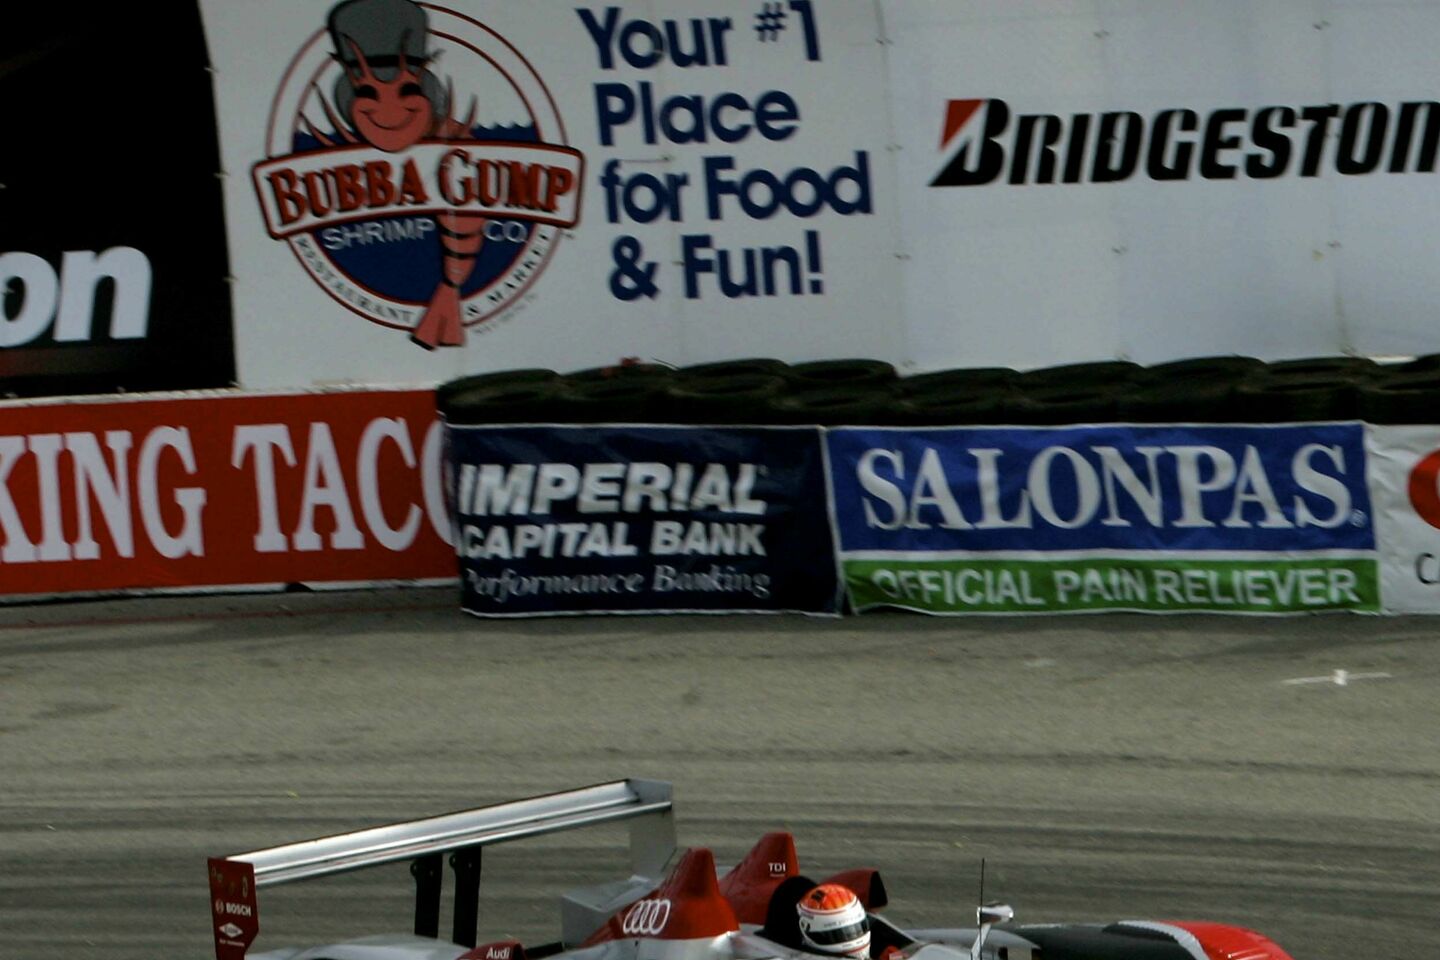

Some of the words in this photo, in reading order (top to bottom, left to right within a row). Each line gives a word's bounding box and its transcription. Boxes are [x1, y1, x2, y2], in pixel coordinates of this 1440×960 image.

[575, 6, 732, 70] Your
[753, 0, 822, 61] #1
[593, 81, 800, 146] Place
[267, 156, 429, 226] BUBBA
[438, 148, 574, 213] GUMP
[599, 158, 690, 224] for
[703, 150, 873, 220] Food
[322, 217, 436, 250] SHRIMP
[609, 235, 660, 301] &
[682, 230, 824, 299] Fun!
[459, 461, 767, 516] IMPERIAL
[856, 443, 1353, 531] SALONPAS
[463, 522, 638, 560] CAPITAL
[649, 519, 768, 557] BANK
[651, 563, 771, 599] Banking
[872, 568, 1045, 605] OFFICIAL
[1054, 568, 1148, 605] PAIN
[1160, 567, 1362, 605] RELIEVER
[768, 862, 787, 872] TDI
[226, 902, 252, 917] BOSCH
[486, 946, 511, 960] Audi
